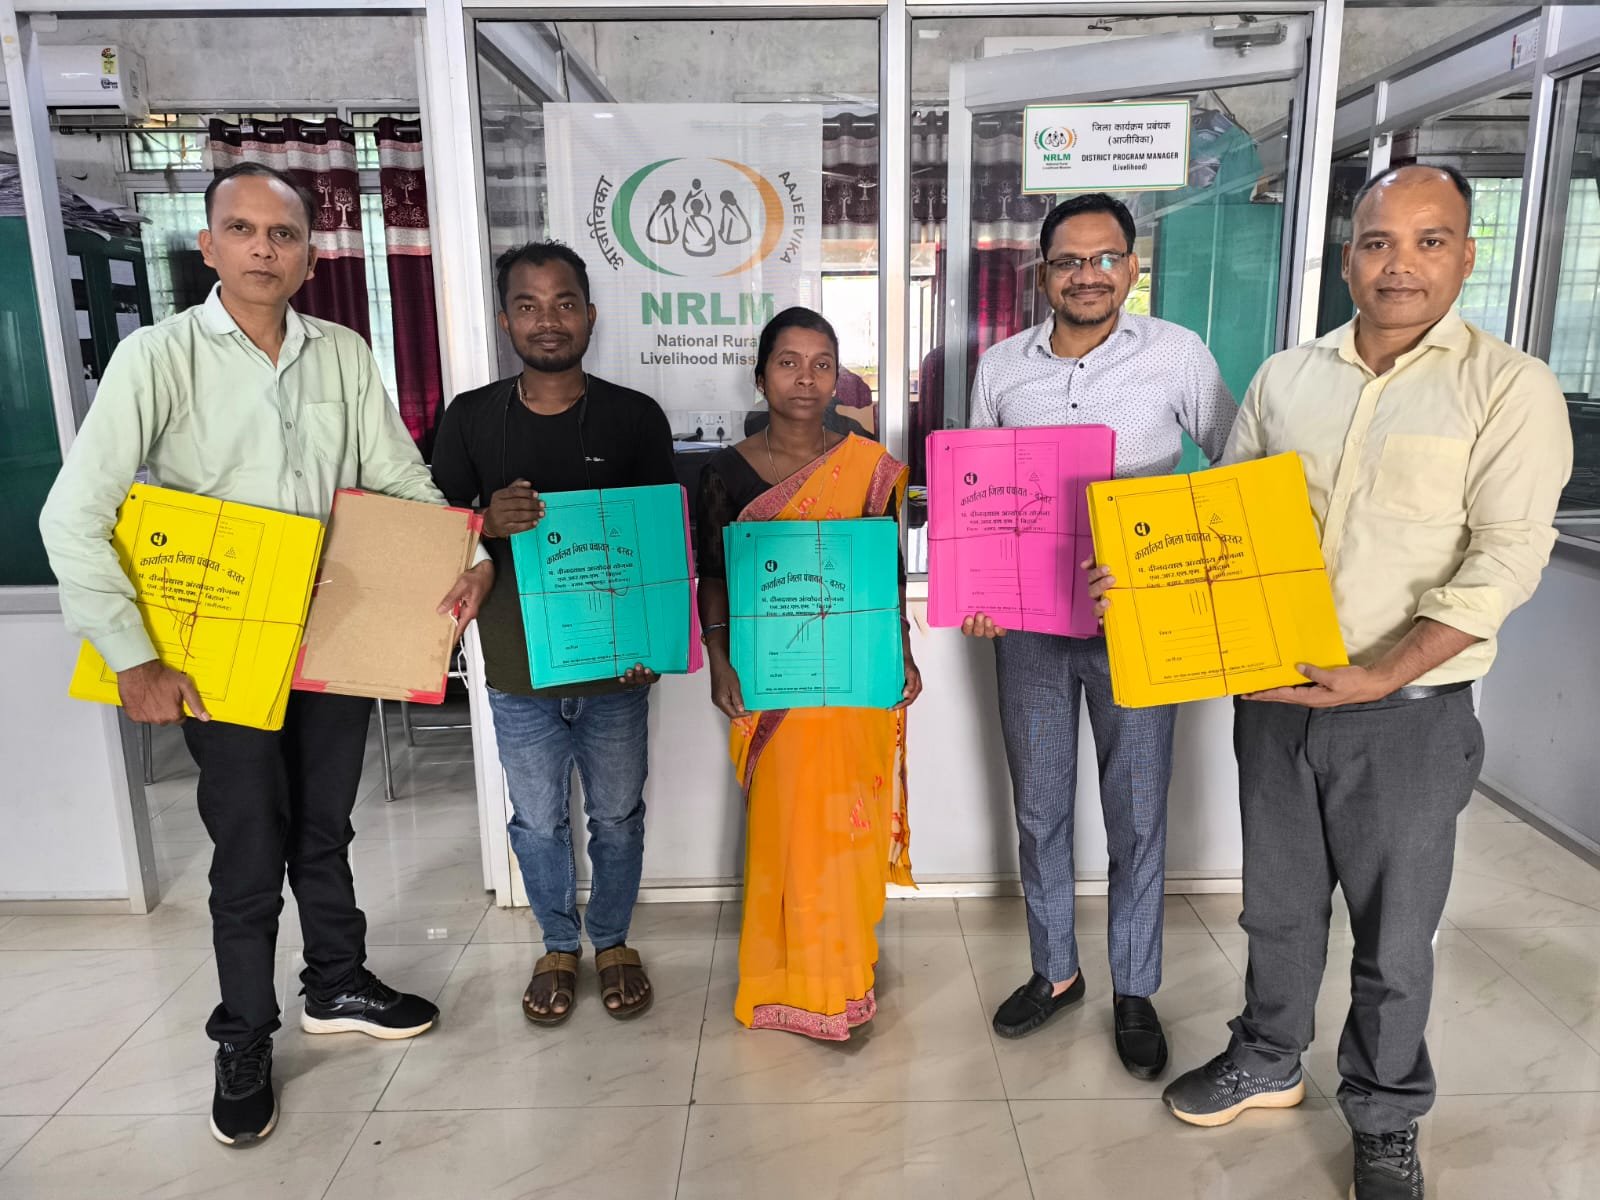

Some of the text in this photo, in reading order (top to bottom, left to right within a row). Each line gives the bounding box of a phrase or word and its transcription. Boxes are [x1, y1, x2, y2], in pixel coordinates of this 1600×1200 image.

[1092, 122, 1111, 132] जिला
[1114, 121, 1143, 132] कार्यक्रम
[1108, 134, 1154, 146] (आजीविका)
[1043, 153, 1071, 161] NRLM
[1081, 152, 1179, 162] DISTRICT PROGRAM MANAGER
[1112, 163, 1148, 171] (Livelihood)
[586, 174, 624, 271] आजीविका
[778, 170, 805, 264] AAJEEVIKA
[641, 292, 774, 325] NRLM
[657, 334, 758, 347] National Rura
[640, 351, 757, 365] Livelihood Miss
[988, 485, 1005, 497] जिला
[1134, 540, 1164, 560] कार्यालय
[1164, 533, 1184, 548] जिला
[175, 550, 196, 565] जिला
[761, 576, 786, 592] कार्यालय
[787, 571, 803, 584] जिला
